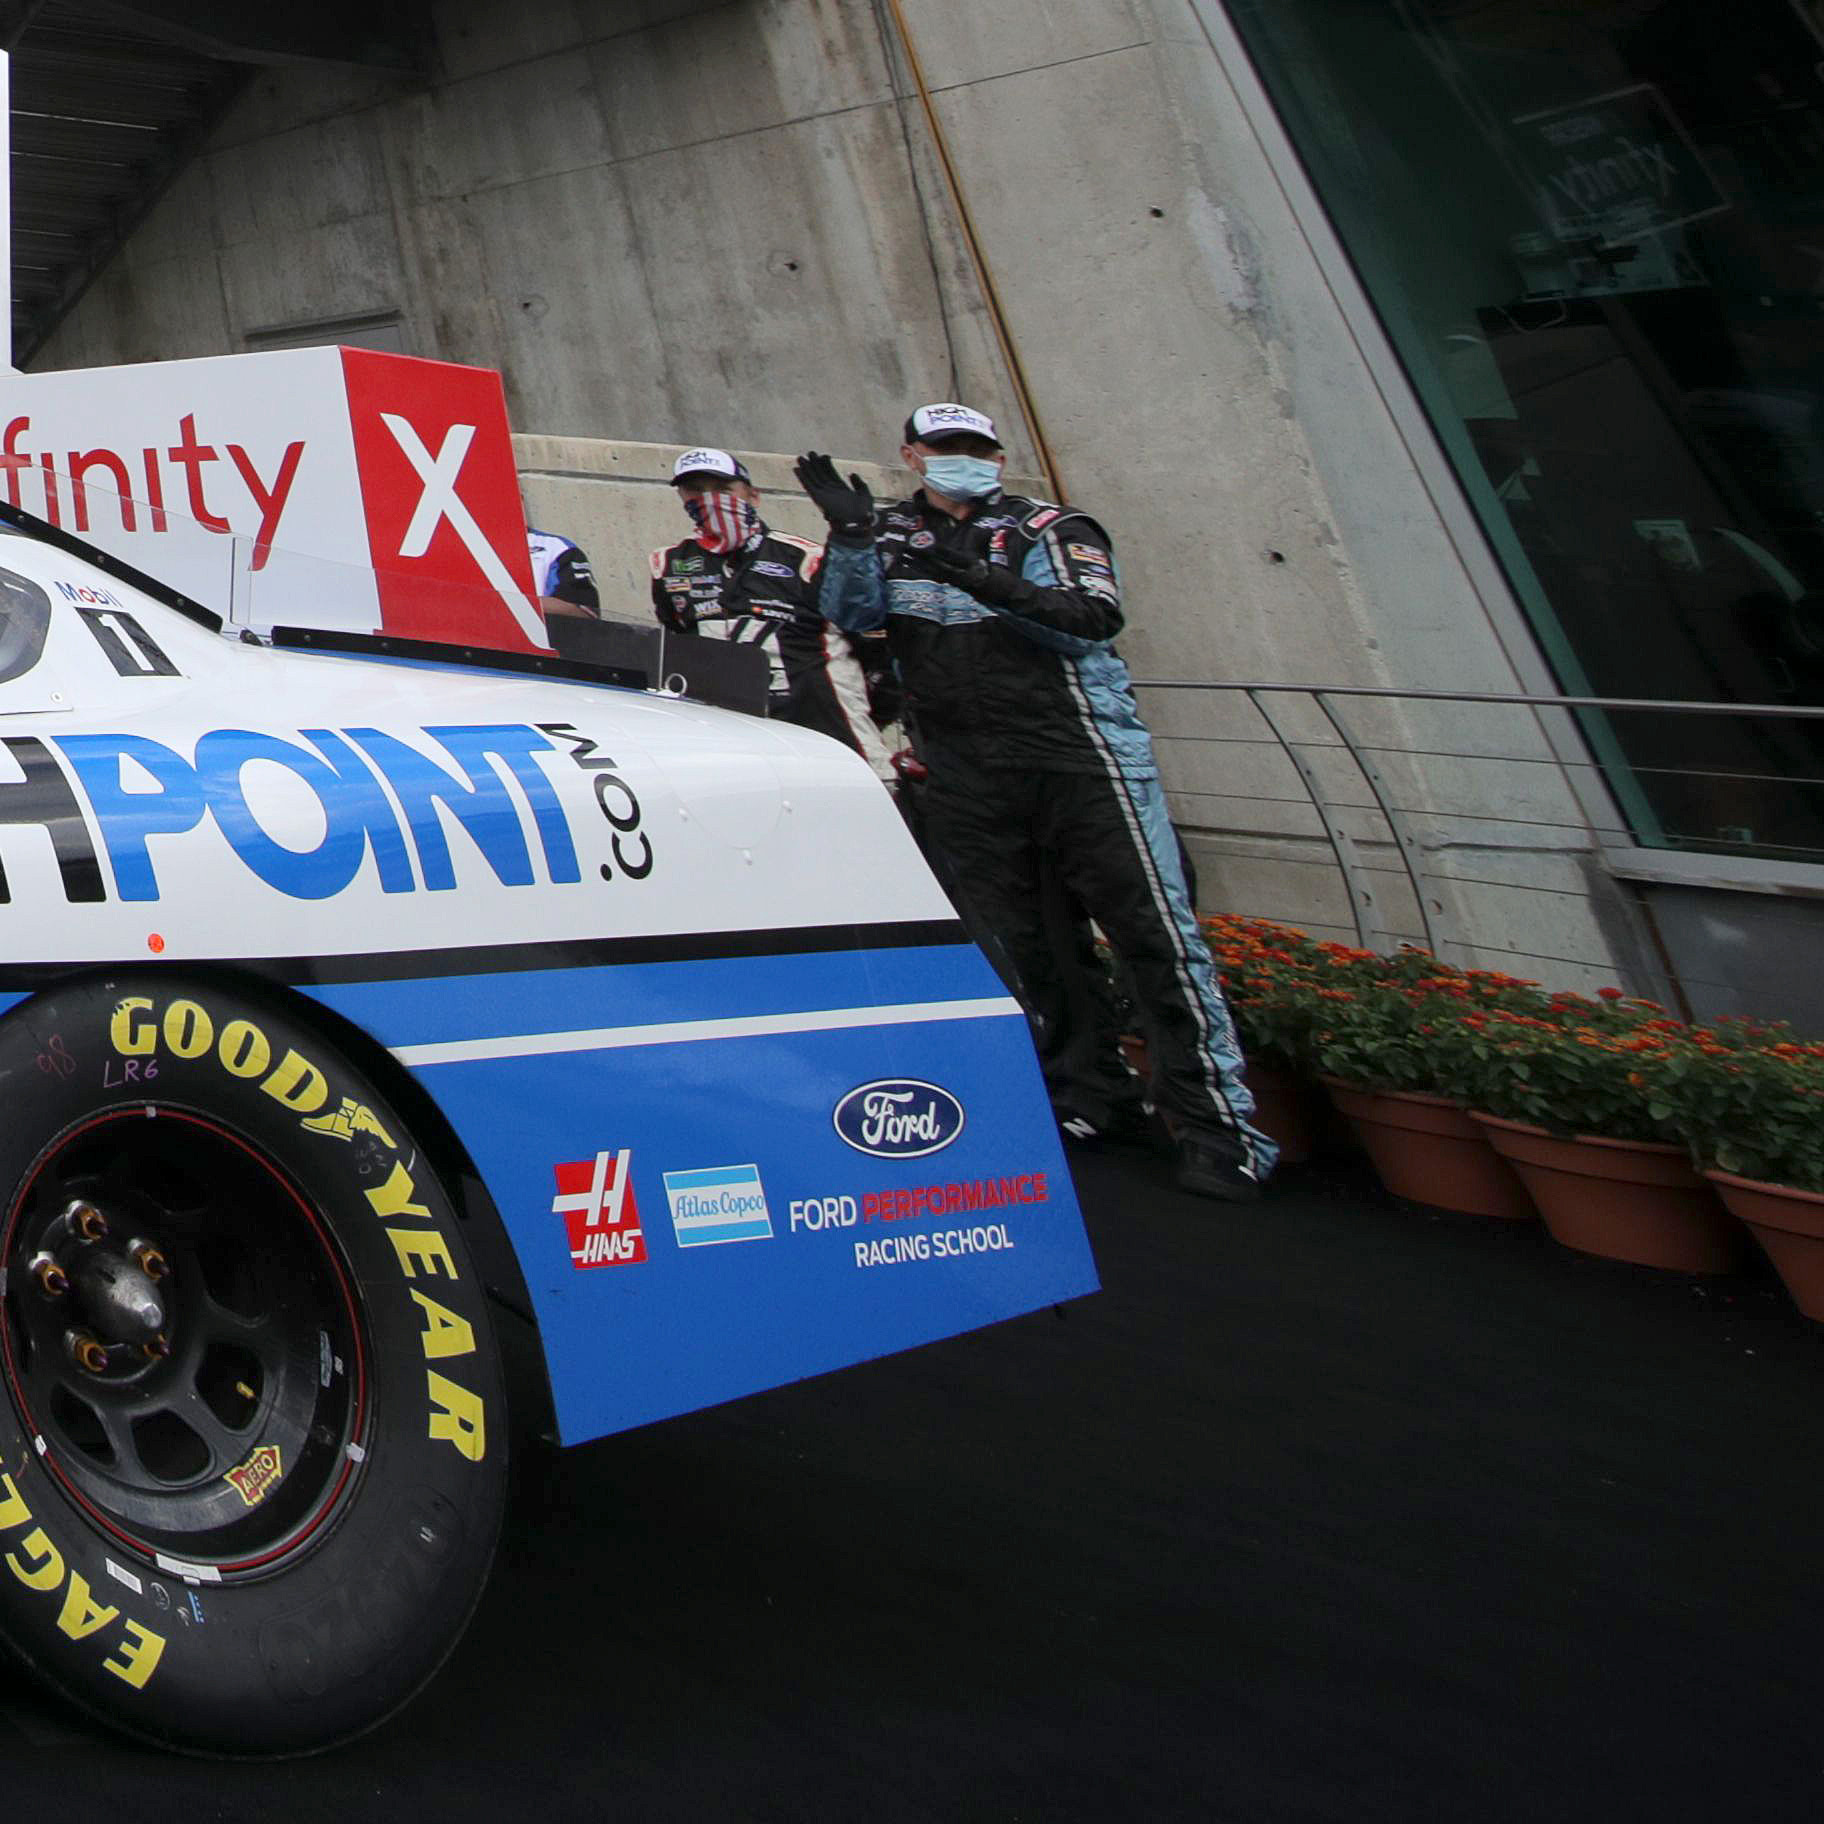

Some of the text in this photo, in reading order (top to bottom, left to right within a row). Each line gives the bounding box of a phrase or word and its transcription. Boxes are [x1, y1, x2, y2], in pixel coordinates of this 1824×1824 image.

[56, 580, 122, 608] Mobil
[861, 1091, 940, 1143] Ford
[674, 1192, 765, 1219] Atlas Copco
[789, 1173, 1049, 1232] FORD PERFORMANCE
[570, 1228, 641, 1264] HAAS
[854, 1224, 1014, 1268] RACING SCHOOL
[241, 1454, 274, 1493] AERO
